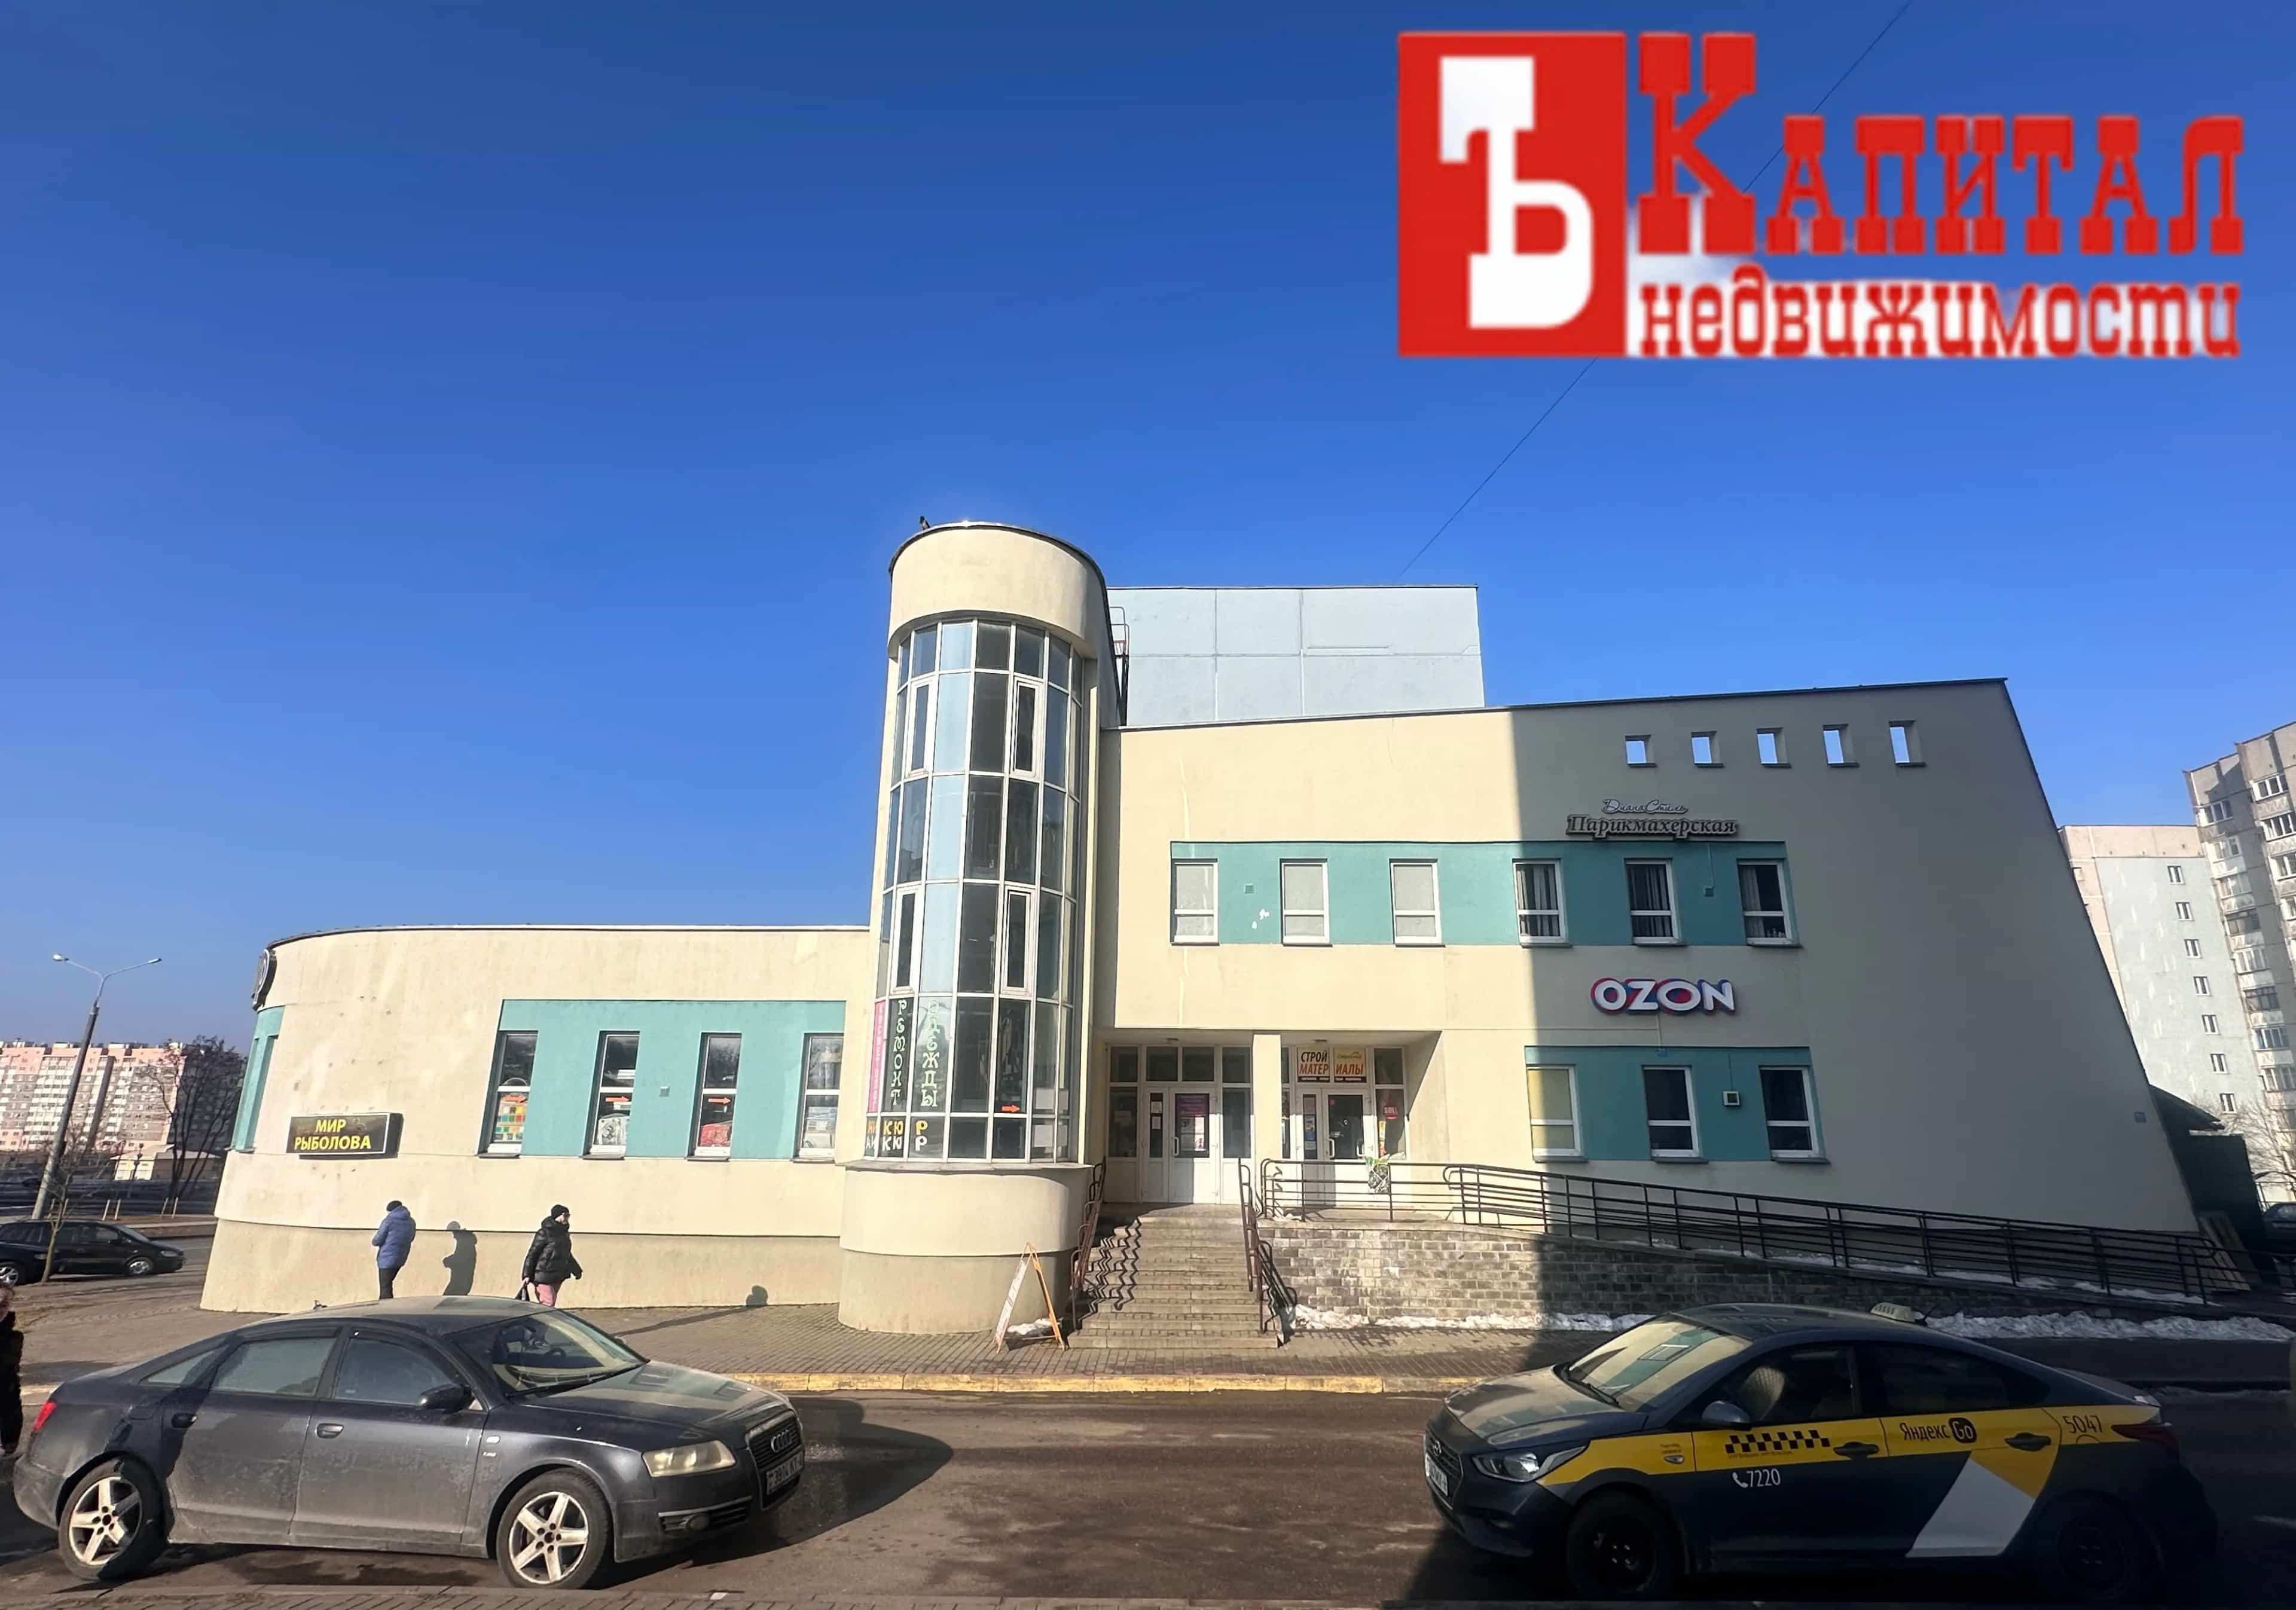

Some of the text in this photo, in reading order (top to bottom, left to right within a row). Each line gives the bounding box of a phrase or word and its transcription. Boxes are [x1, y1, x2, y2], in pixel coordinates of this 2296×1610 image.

[1567, 815, 1736, 837] Парикмахерская
[1590, 977, 1735, 1015] OZON
[1301, 1049, 1328, 1062] СТРОЙ
[316, 1119, 346, 1133] МИР
[294, 1135, 371, 1151] РЫБОЛОВА
[1899, 1420, 1973, 1441] Яндекс Go
[2062, 1415, 2103, 1434] 5047
[1746, 1468, 1781, 1488] 7220
